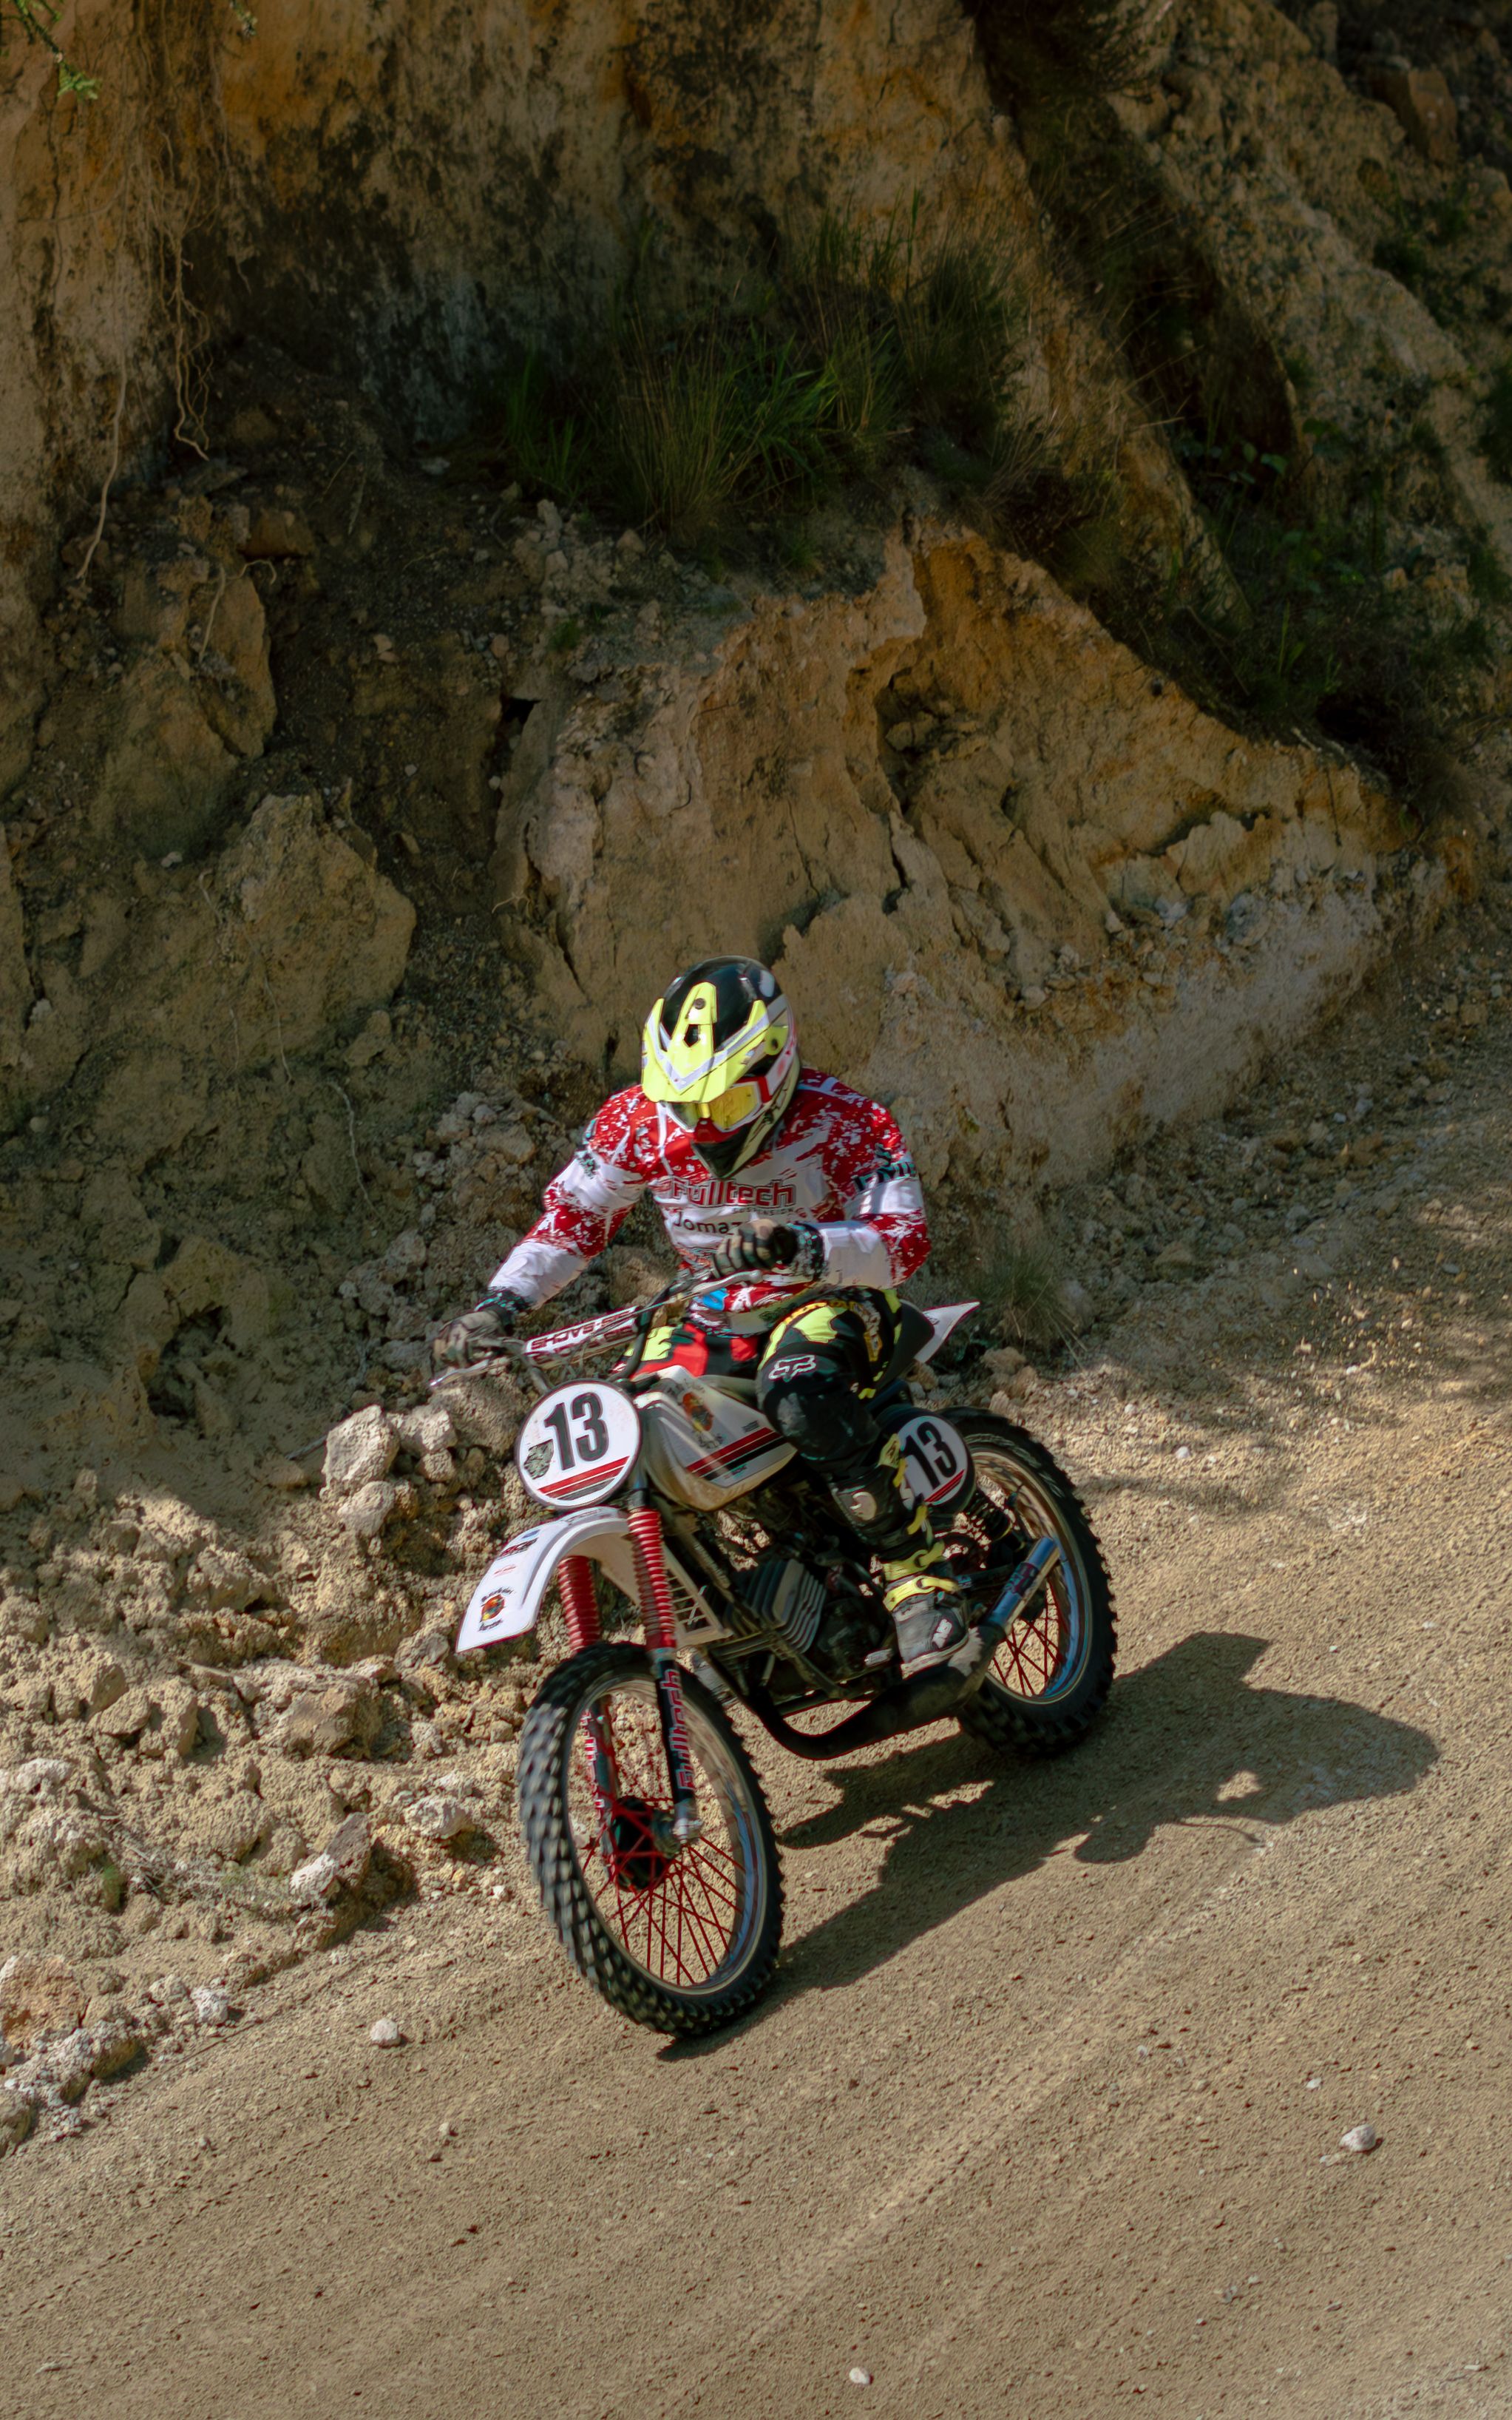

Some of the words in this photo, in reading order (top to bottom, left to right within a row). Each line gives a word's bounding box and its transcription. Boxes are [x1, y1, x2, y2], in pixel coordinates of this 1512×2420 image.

[671, 1175, 797, 1208] Fulltech
[543, 1391, 609, 1471] 13
[899, 1422, 957, 1490] 13
